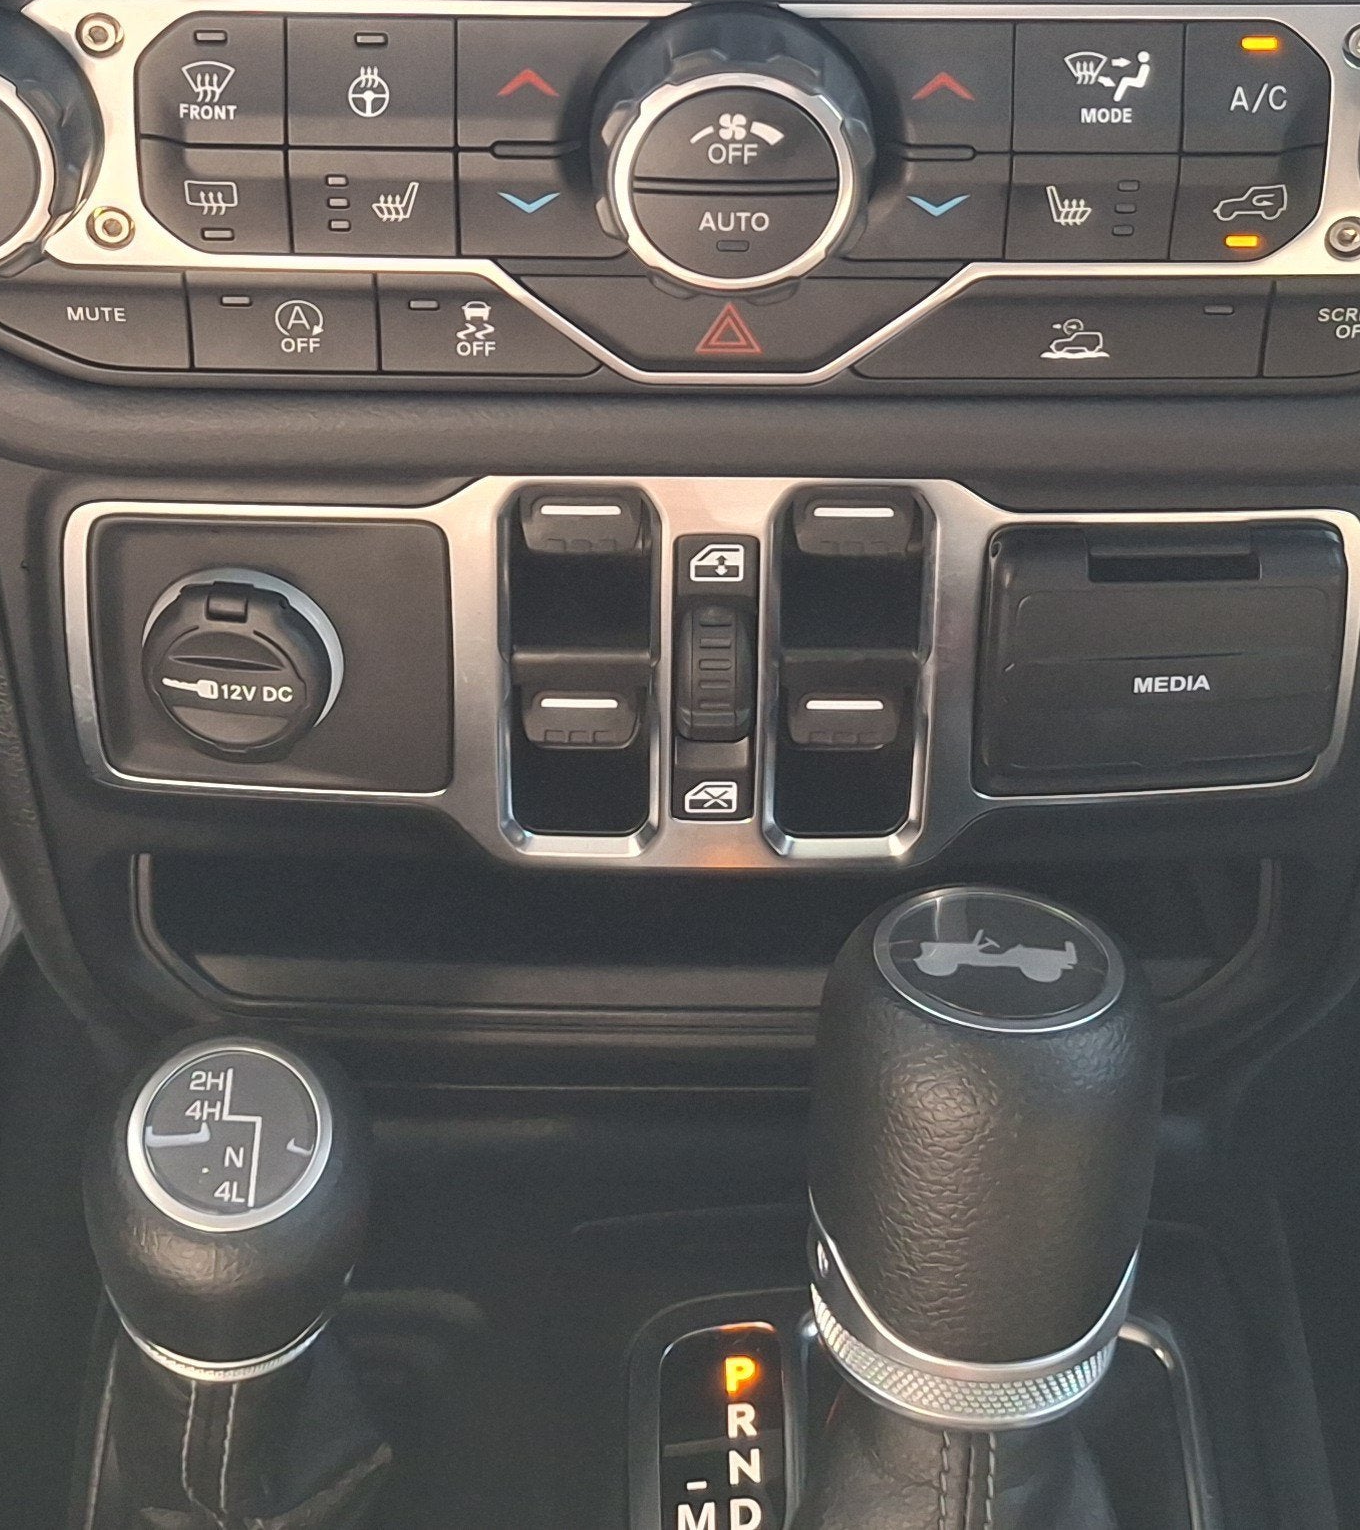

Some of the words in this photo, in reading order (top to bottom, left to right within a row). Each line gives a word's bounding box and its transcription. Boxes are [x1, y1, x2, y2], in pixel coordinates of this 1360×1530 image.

[1230, 84, 1288, 112] A/C
[178, 103, 237, 121] FRONT
[1080, 107, 1133, 124] MODE
[707, 143, 758, 165] OFF
[698, 211, 769, 233] AUTO
[66, 304, 127, 323] MUTE
[279, 336, 321, 354] OFF
[455, 340, 496, 357] OFF
[220, 683, 257, 702] 12V
[262, 684, 293, 703] DC
[1133, 674, 1210, 695] MEDIA
[190, 1070, 224, 1091] 2H
[185, 1100, 222, 1121] 4H
[224, 1146, 244, 1168] N
[214, 1181, 246, 1203] 4L
[725, 1356, 756, 1392] P
[727, 1402, 758, 1439] R
[728, 1448, 761, 1485] N
[677, 1502, 716, 1530] M
[730, 1498, 762, 1530] D
